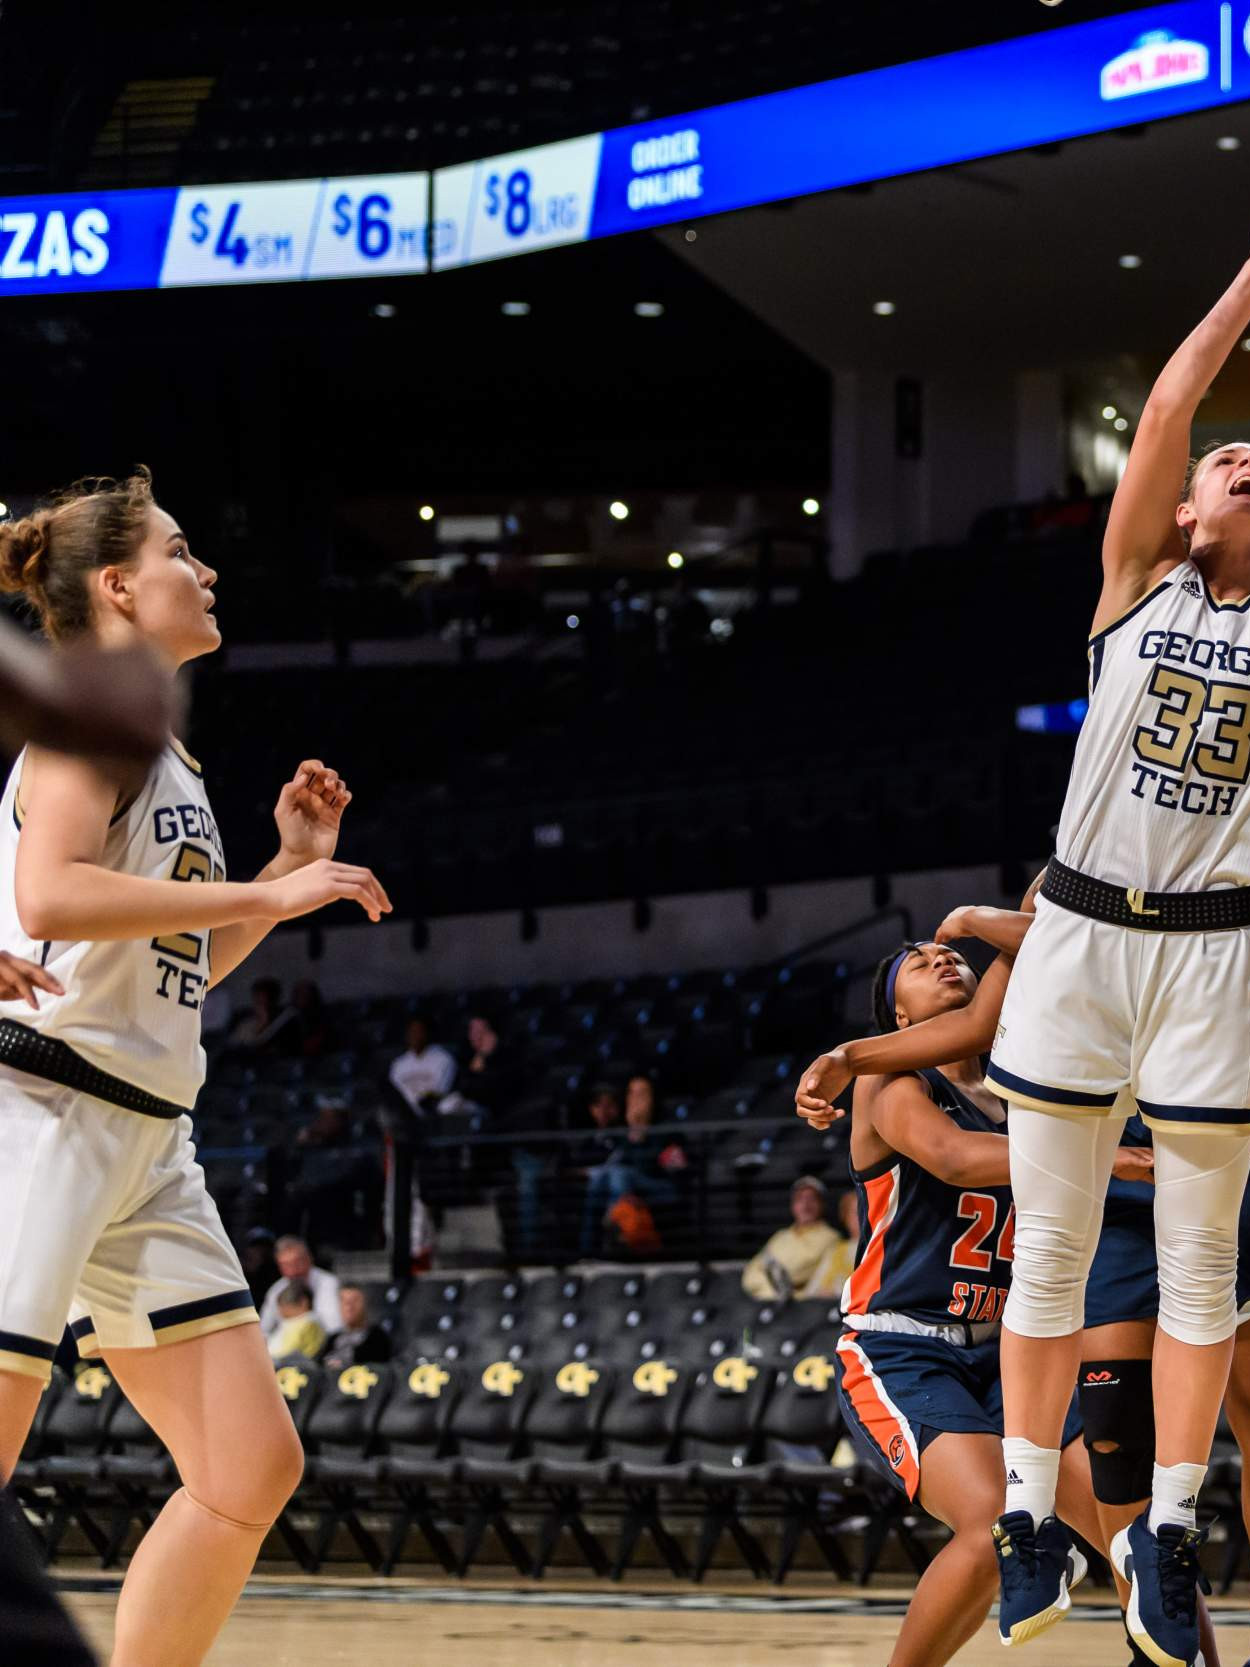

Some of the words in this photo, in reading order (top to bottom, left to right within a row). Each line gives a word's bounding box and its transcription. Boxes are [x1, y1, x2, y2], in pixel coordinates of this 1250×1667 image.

[631, 131, 699, 173] ORDER
[628, 164, 704, 210] ONLINE
[0, 208, 110, 278] ZAS
[1131, 761, 1239, 816] TECH
[156, 957, 209, 1013] TE
